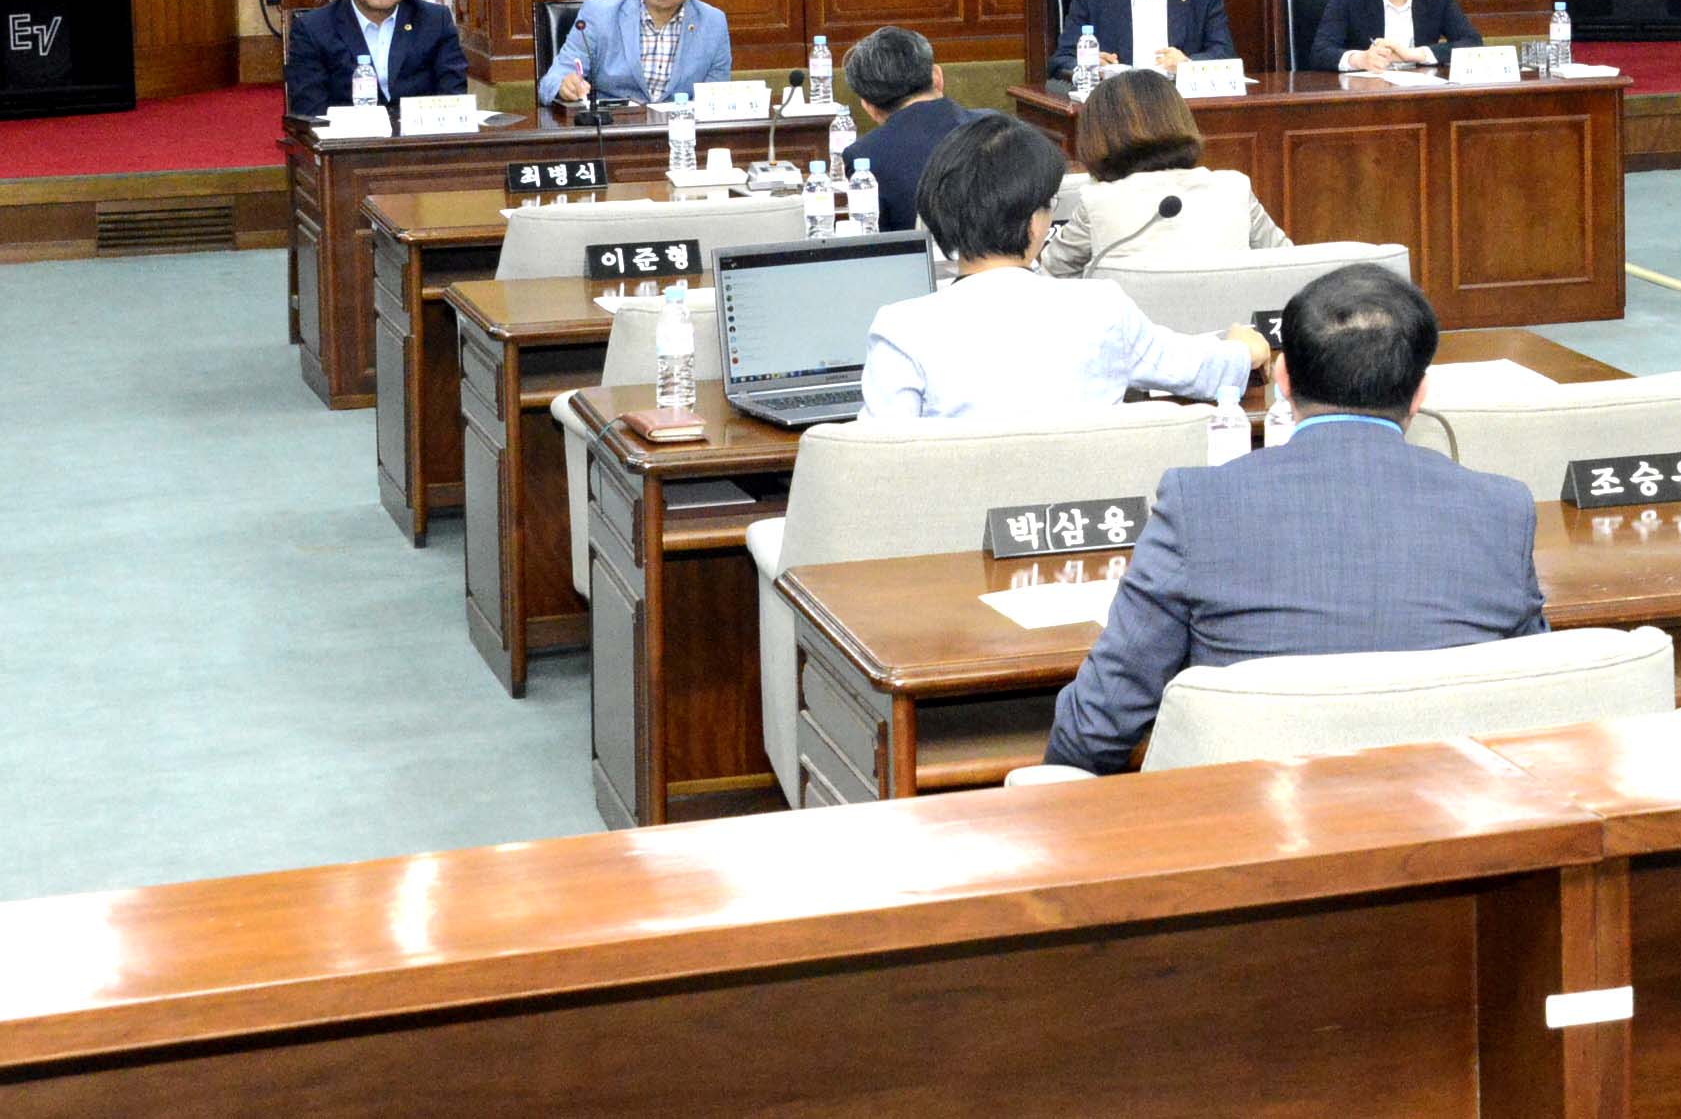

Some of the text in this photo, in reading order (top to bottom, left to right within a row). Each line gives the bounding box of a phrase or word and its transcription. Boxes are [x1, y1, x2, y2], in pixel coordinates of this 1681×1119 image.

[520, 162, 597, 188] 최병식
[601, 243, 689, 274] 이준형
[1006, 505, 1135, 550] 박삼용
